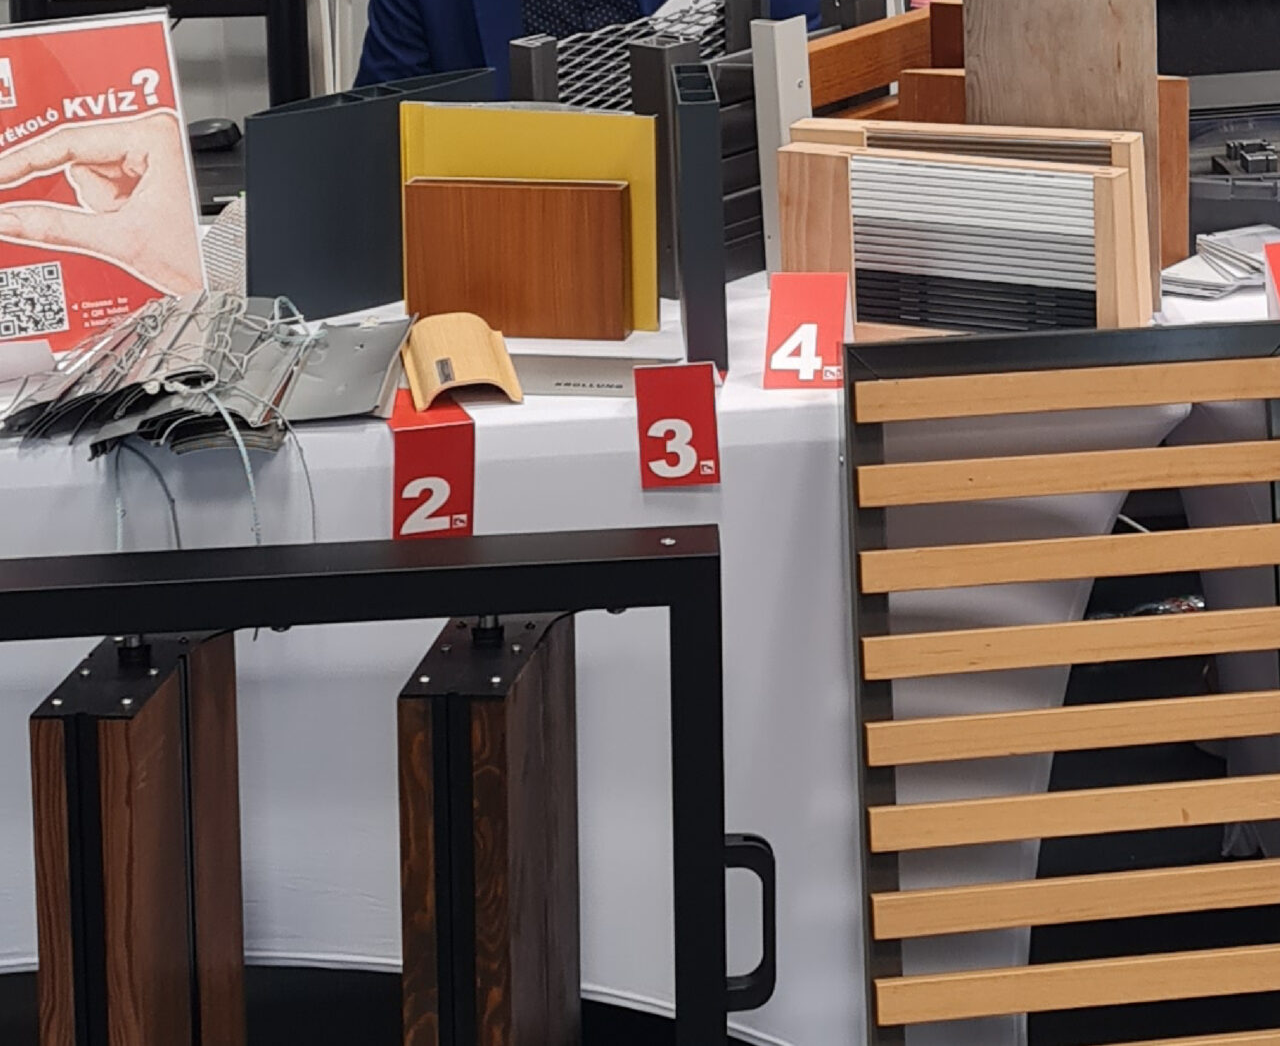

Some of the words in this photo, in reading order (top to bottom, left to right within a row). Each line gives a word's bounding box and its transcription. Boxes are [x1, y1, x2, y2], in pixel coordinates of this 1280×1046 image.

[770, 323, 823, 381] 4
[646, 418, 698, 479] 3
[399, 476, 451, 536] 2
